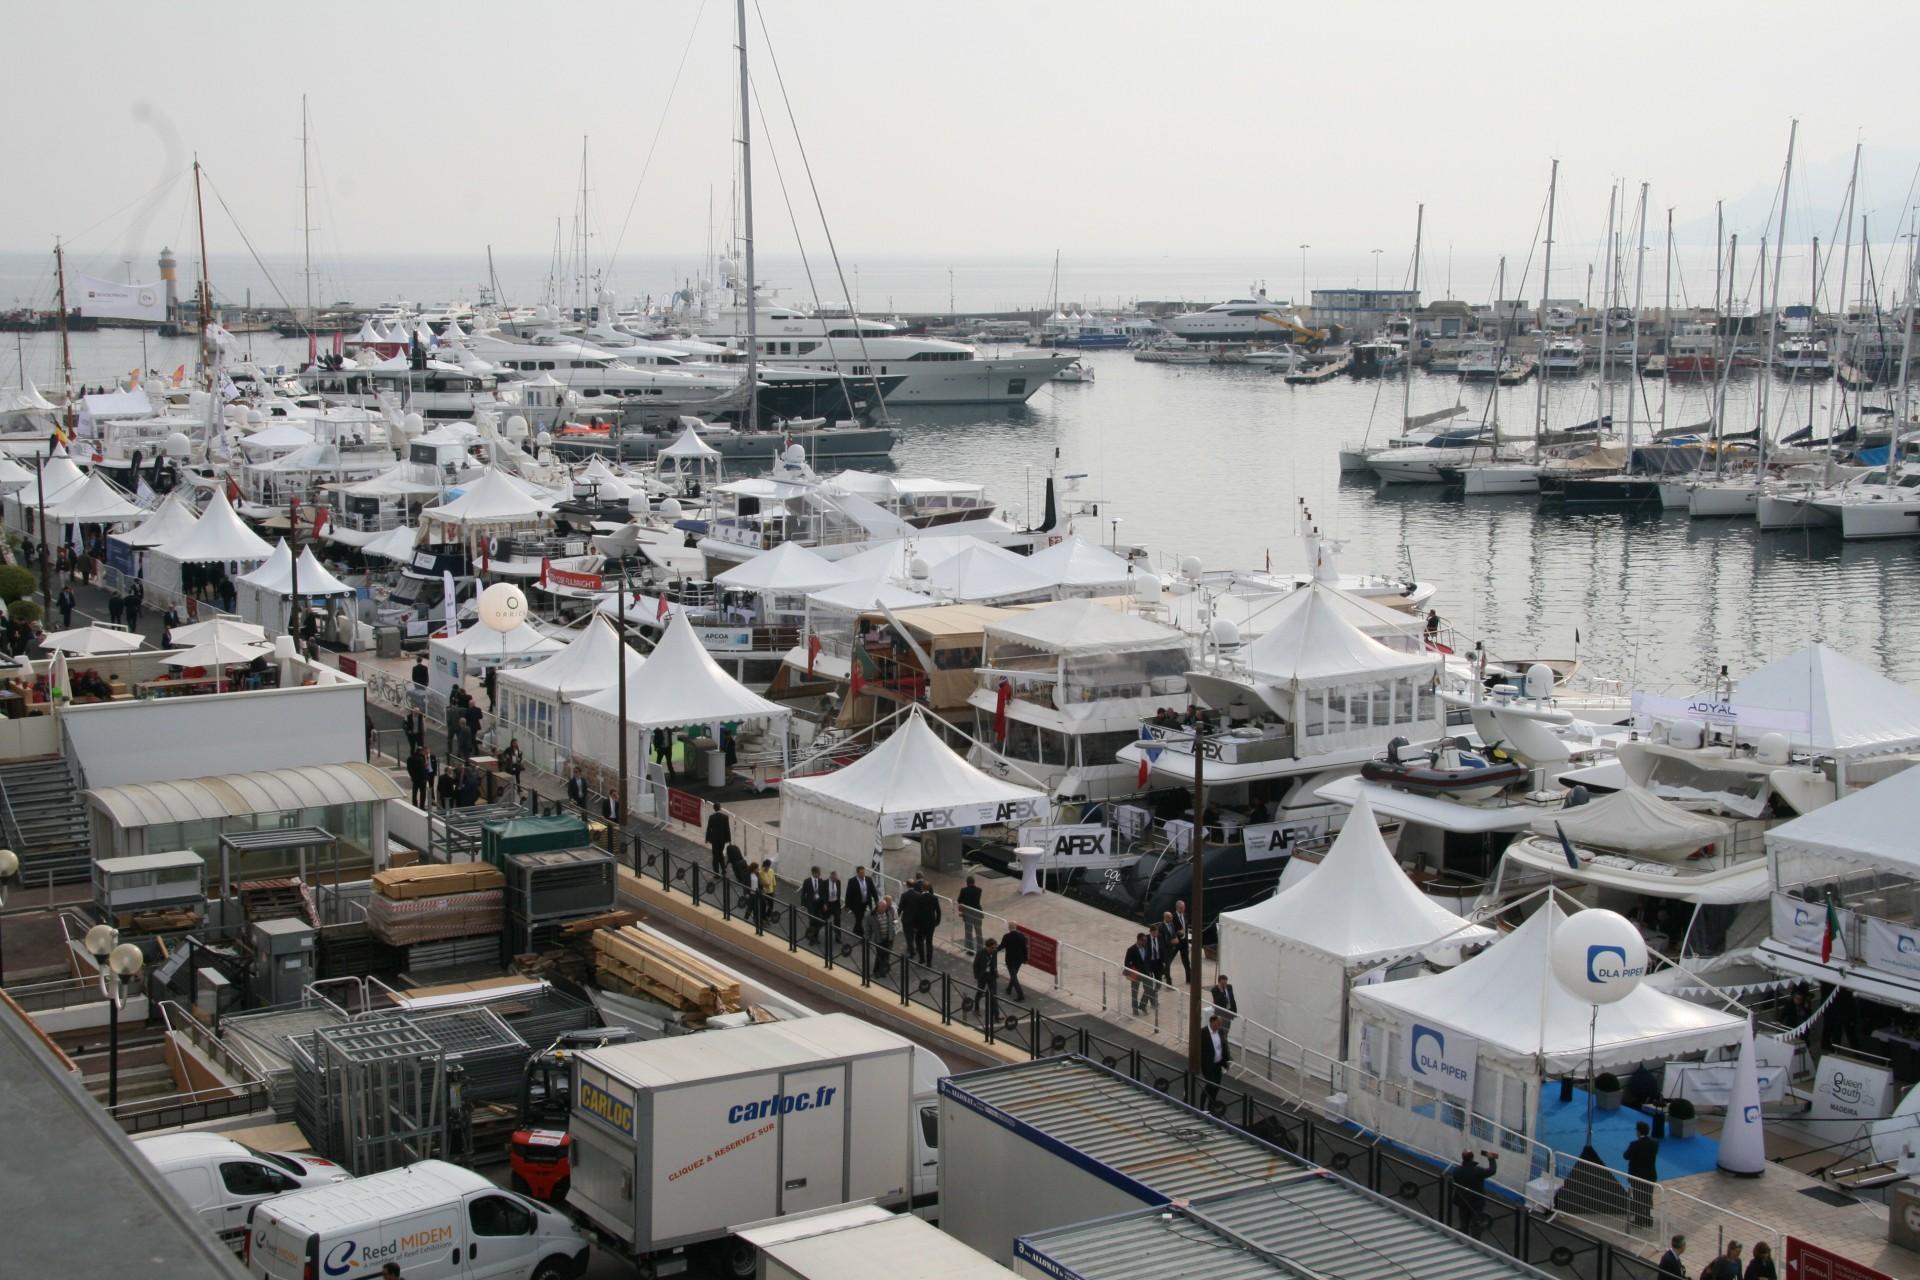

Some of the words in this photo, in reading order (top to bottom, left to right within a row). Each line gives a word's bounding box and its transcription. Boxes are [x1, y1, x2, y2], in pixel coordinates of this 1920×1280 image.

[1688, 702, 1737, 715] ADYAL
[911, 809, 956, 831] AFEX
[996, 800, 1038, 821] AFEX
[1054, 834, 1105, 856] AFEX
[1268, 825, 1319, 851] AFEX
[1598, 968, 1620, 978] DLA
[1622, 967, 1644, 978] PIPER
[1420, 1055, 1438, 1071] DLA
[1440, 1062, 1467, 1081] PIPER
[1832, 1080, 1861, 1103] South
[1833, 1072, 1863, 1091] Queen
[582, 1084, 632, 1131] CARLOC
[728, 1085, 837, 1125] carloc.fr
[668, 1158, 705, 1182] CLIQUEZ
[706, 1154, 713, 1163] &
[714, 1132, 757, 1158] RESERVEZ
[758, 1122, 775, 1137] SUR
[362, 1240, 397, 1261] Reed
[400, 1224, 453, 1250] MIDEM
